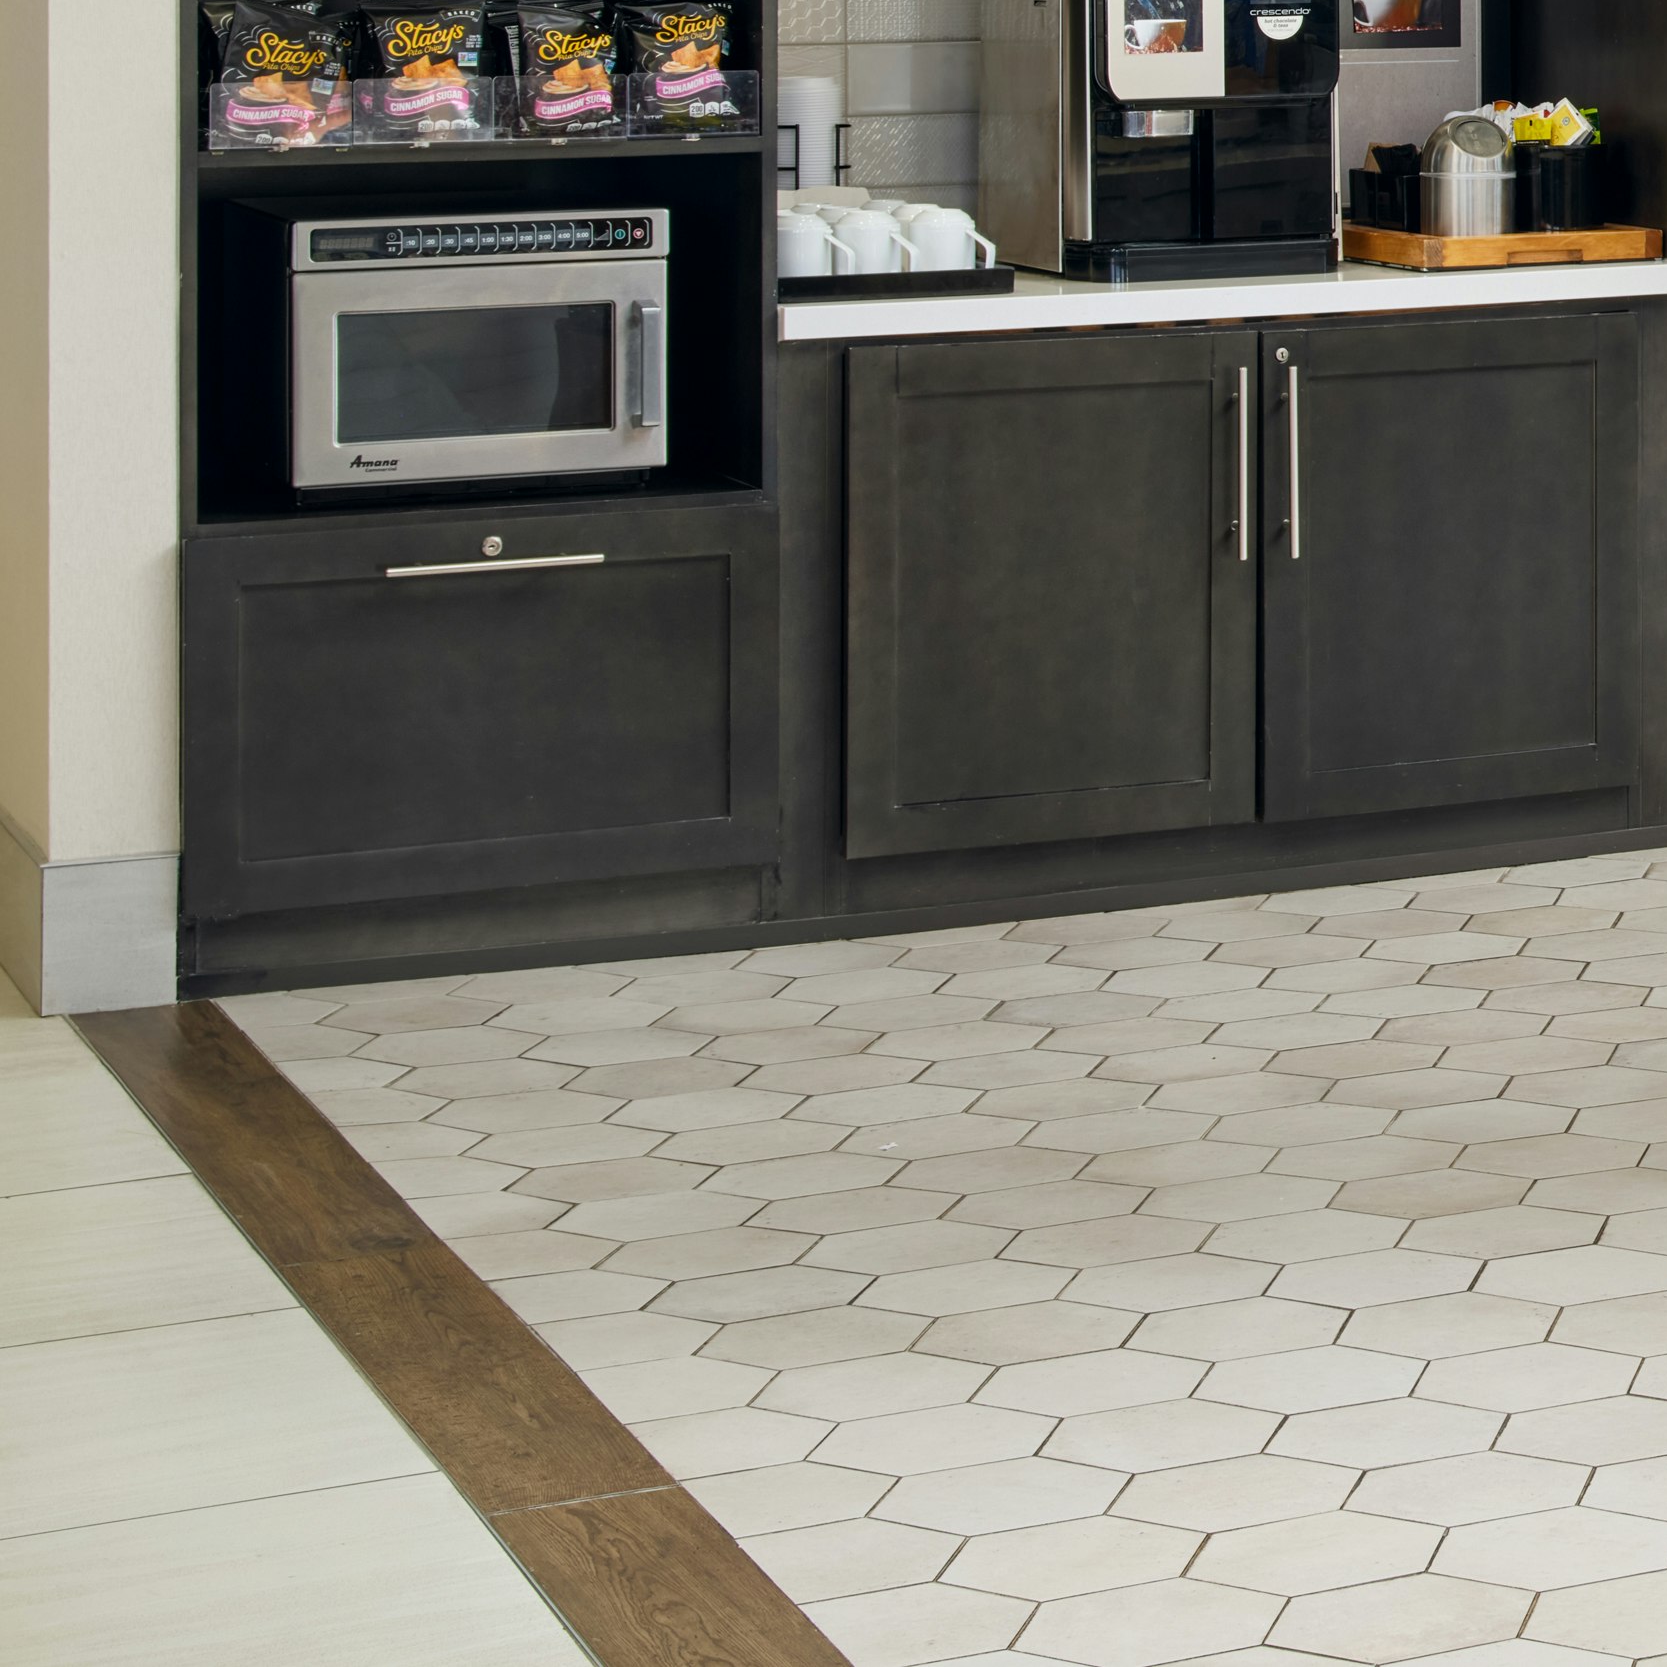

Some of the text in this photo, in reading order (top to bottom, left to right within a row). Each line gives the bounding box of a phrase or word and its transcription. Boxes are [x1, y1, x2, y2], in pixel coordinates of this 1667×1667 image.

[388, 20, 465, 56] Stacy's
[539, 30, 612, 61] Stacy's
[246, 33, 327, 75] Stacy's
[233, 109, 279, 120] CINNAMON
[390, 91, 463, 112] CINNAMON SUGAR
[350, 455, 400, 468] Amana
